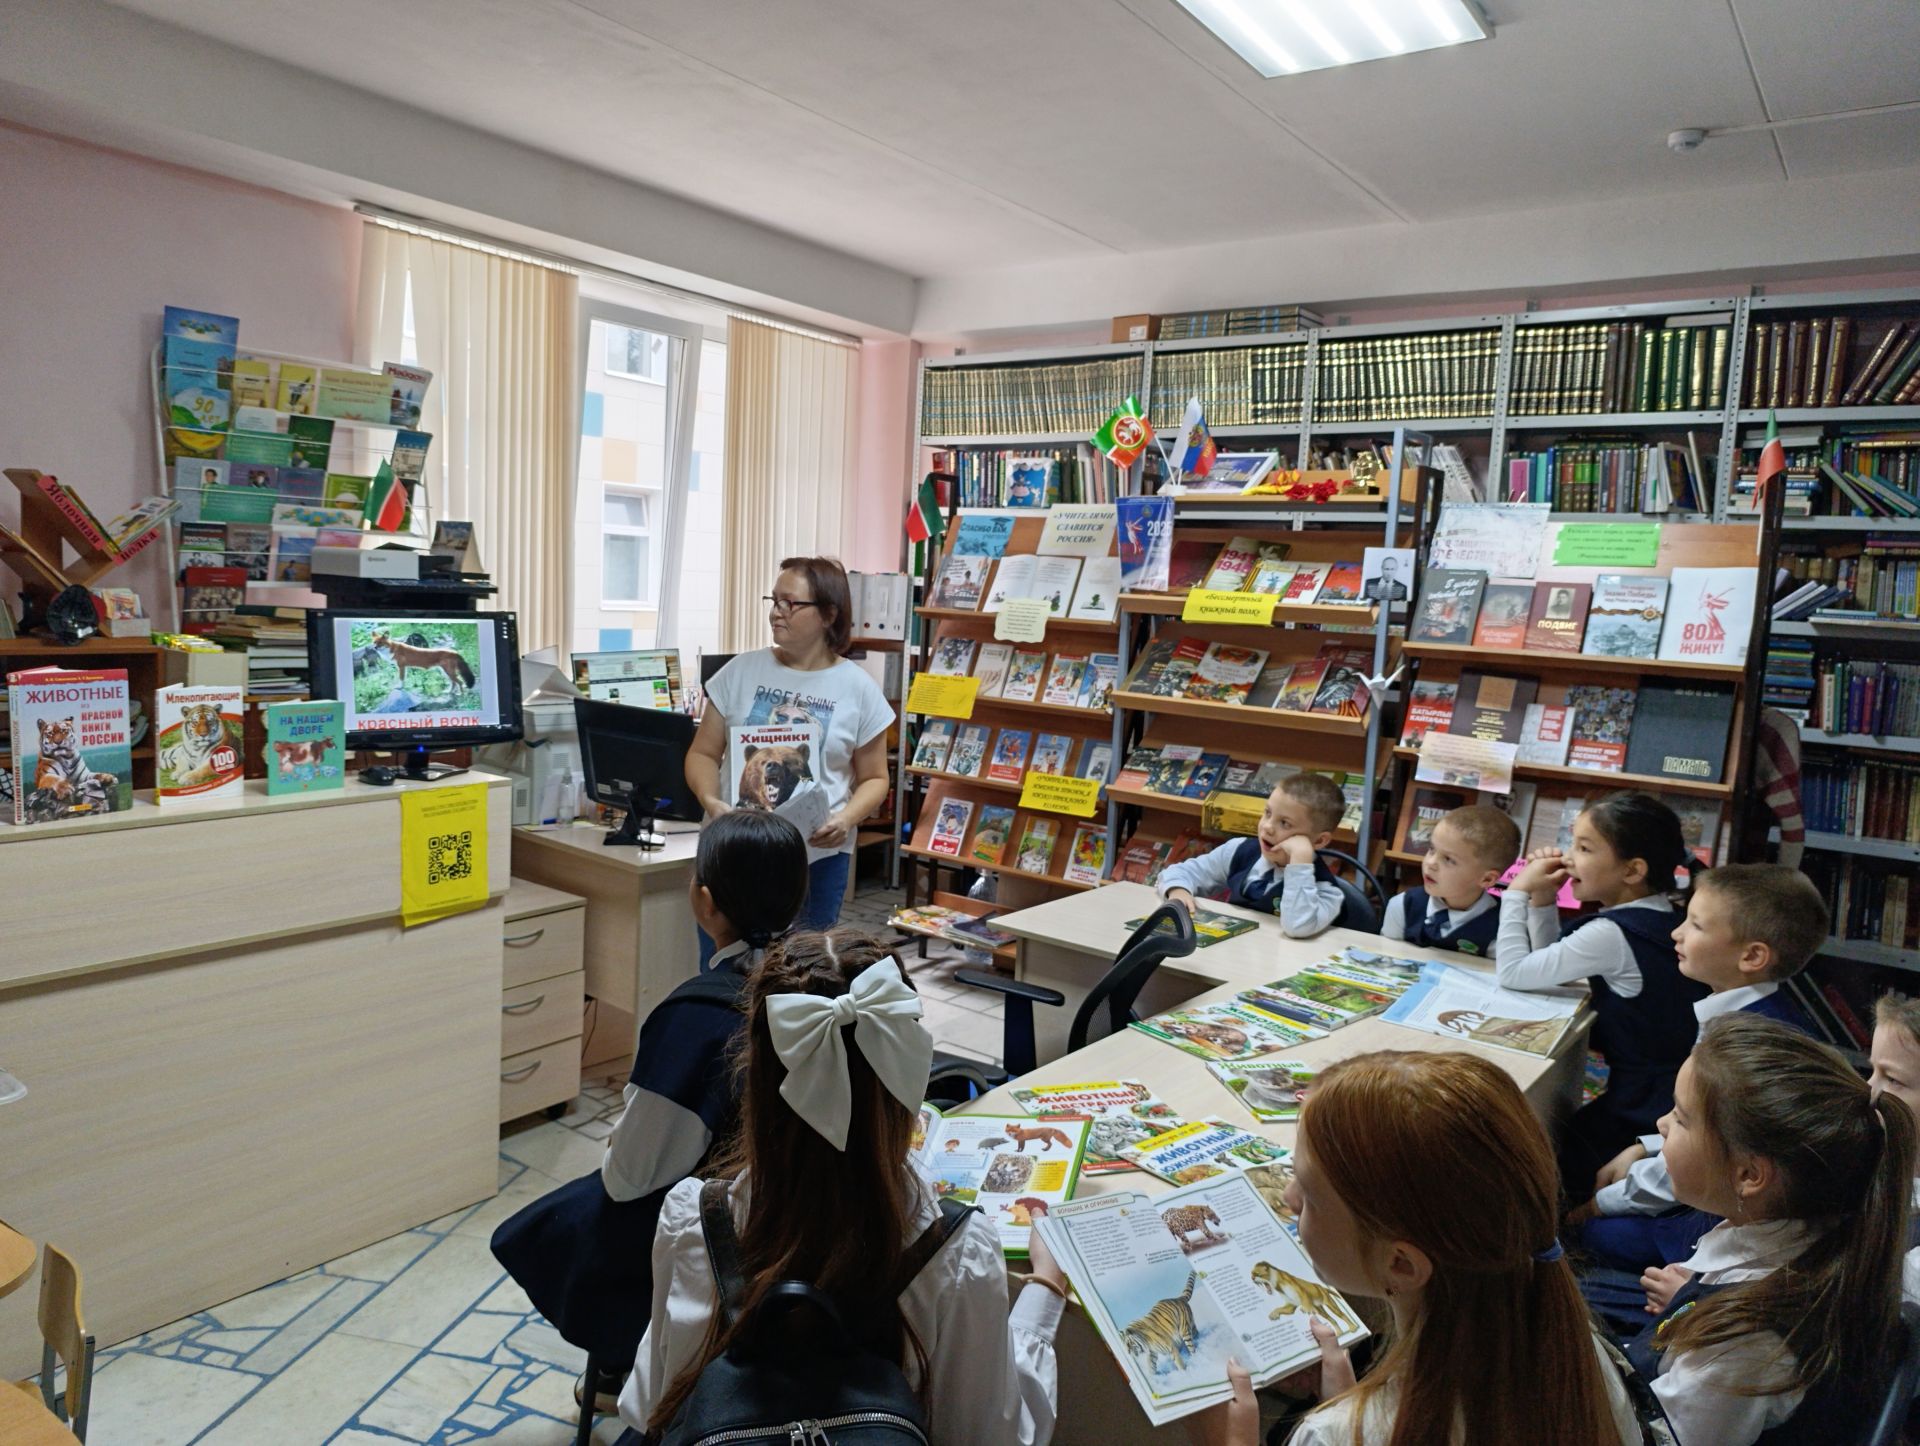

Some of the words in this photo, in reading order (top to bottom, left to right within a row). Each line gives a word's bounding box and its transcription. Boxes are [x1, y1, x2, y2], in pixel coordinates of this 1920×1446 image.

[194, 397, 214, 413] 90
[1053, 511, 1115, 520] «УЧИТЕЛЯМИ
[1056, 523, 1104, 532] СЛАВИТСЯ
[1056, 535, 1097, 543] РОССИЯ»
[1199, 605, 1236, 615] книжный
[1683, 623, 1707, 640] 80
[26, 686, 124, 704] ЖИВОТНЫЕ
[166, 692, 240, 704] Млекопитающие
[754, 685, 793, 704] RISE
[806, 695, 837, 712] SHINE
[81, 708, 123, 721] КРАСНОЙ
[280, 716, 293, 725] НА
[296, 714, 334, 724] НАШЕМ
[81, 721, 111, 733] КНИГИ
[357, 715, 433, 730] красный
[440, 716, 480, 727] волк
[289, 725, 324, 737] ДВОРЕ
[82, 732, 124, 746] РОССИИ
[740, 733, 810, 744] Хищники
[212, 750, 235, 767] 100
[1662, 756, 1712, 777] ПАМЯТЬ
[1036, 1090, 1137, 1104] ЖИВОТНЫЕ
[1051, 1099, 1139, 1111] АВСТРАЛИИ
[1151, 1129, 1236, 1164] ЖИВОТНЫЕ
[1160, 1152, 1207, 1174] ЮЖНОЙ
[1206, 1133, 1255, 1157] АМЕРИКИ
